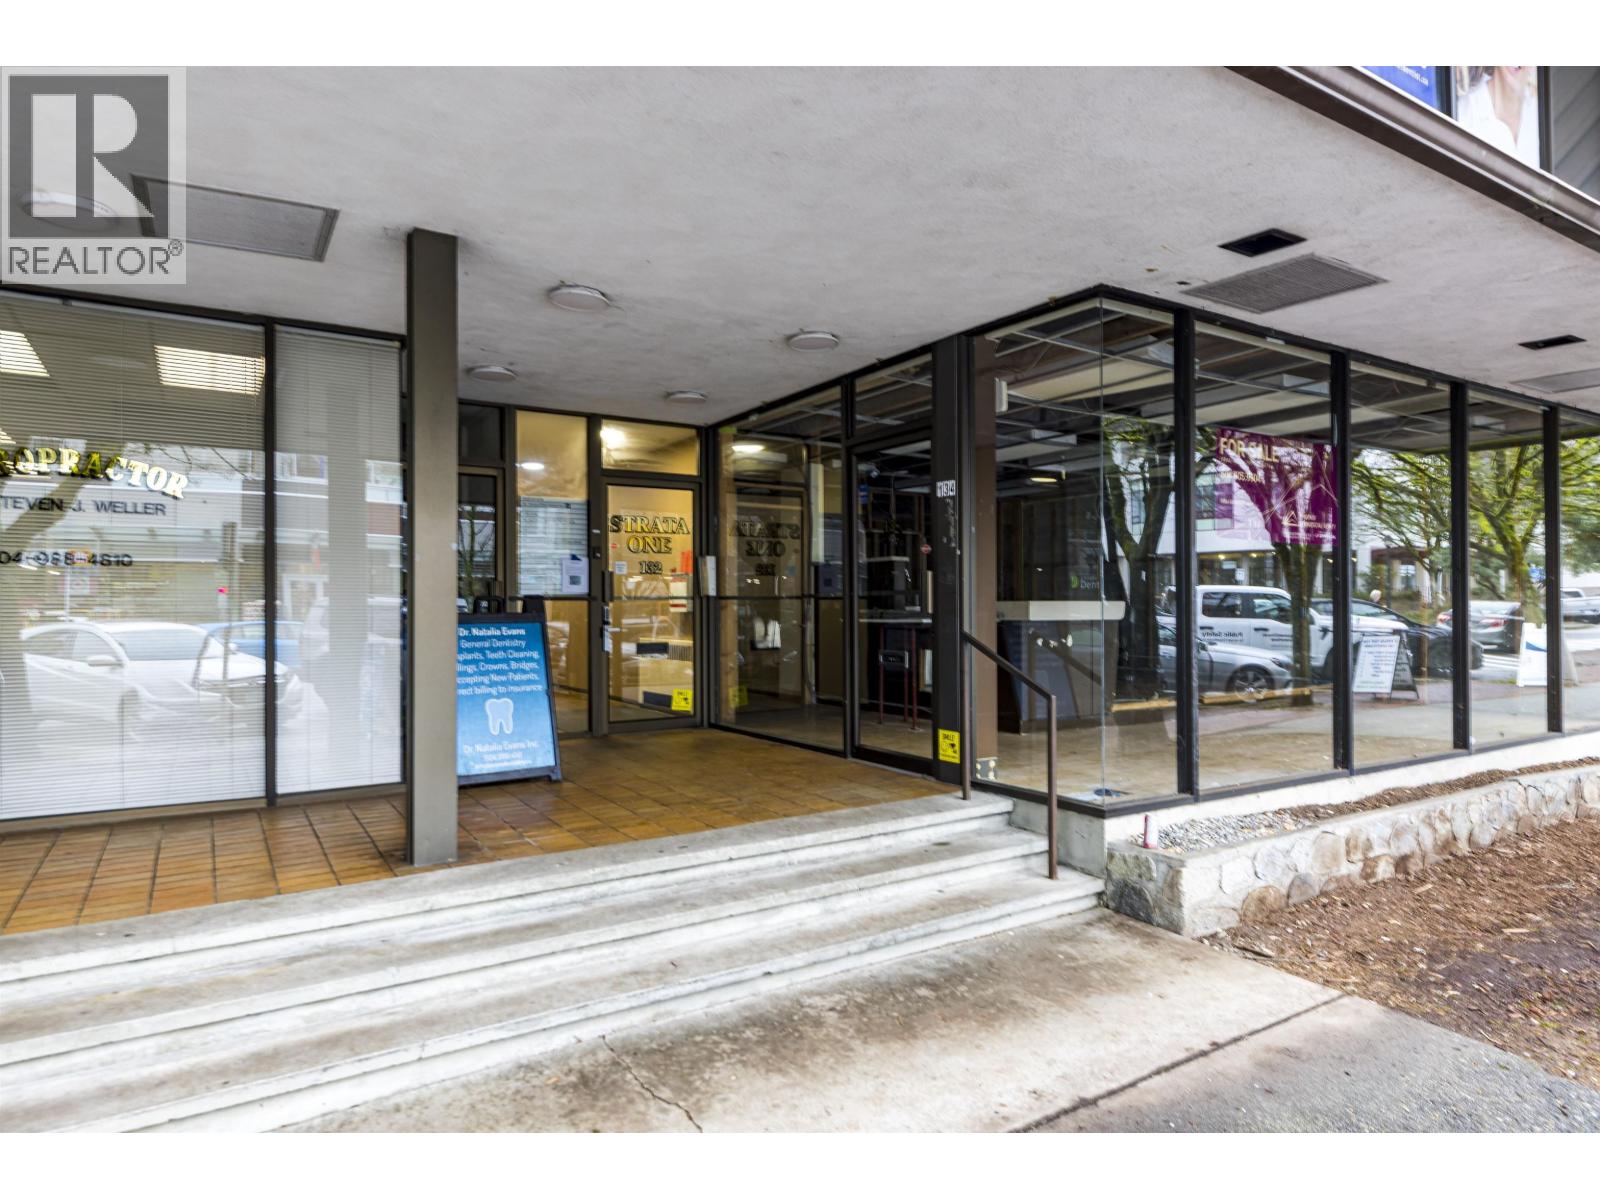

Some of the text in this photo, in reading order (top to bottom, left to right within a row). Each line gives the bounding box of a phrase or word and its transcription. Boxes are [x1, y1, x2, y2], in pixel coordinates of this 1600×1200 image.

[1219, 437, 1280, 463] FOR SALE
[93, 499, 167, 516] WELLER
[608, 514, 690, 535] STRATA
[627, 535, 672, 554] ONE
[459, 627, 526, 637] Dr. Natalia Evans
[460, 639, 527, 649] General Dentistry
[486, 650, 507, 660] Teeth
